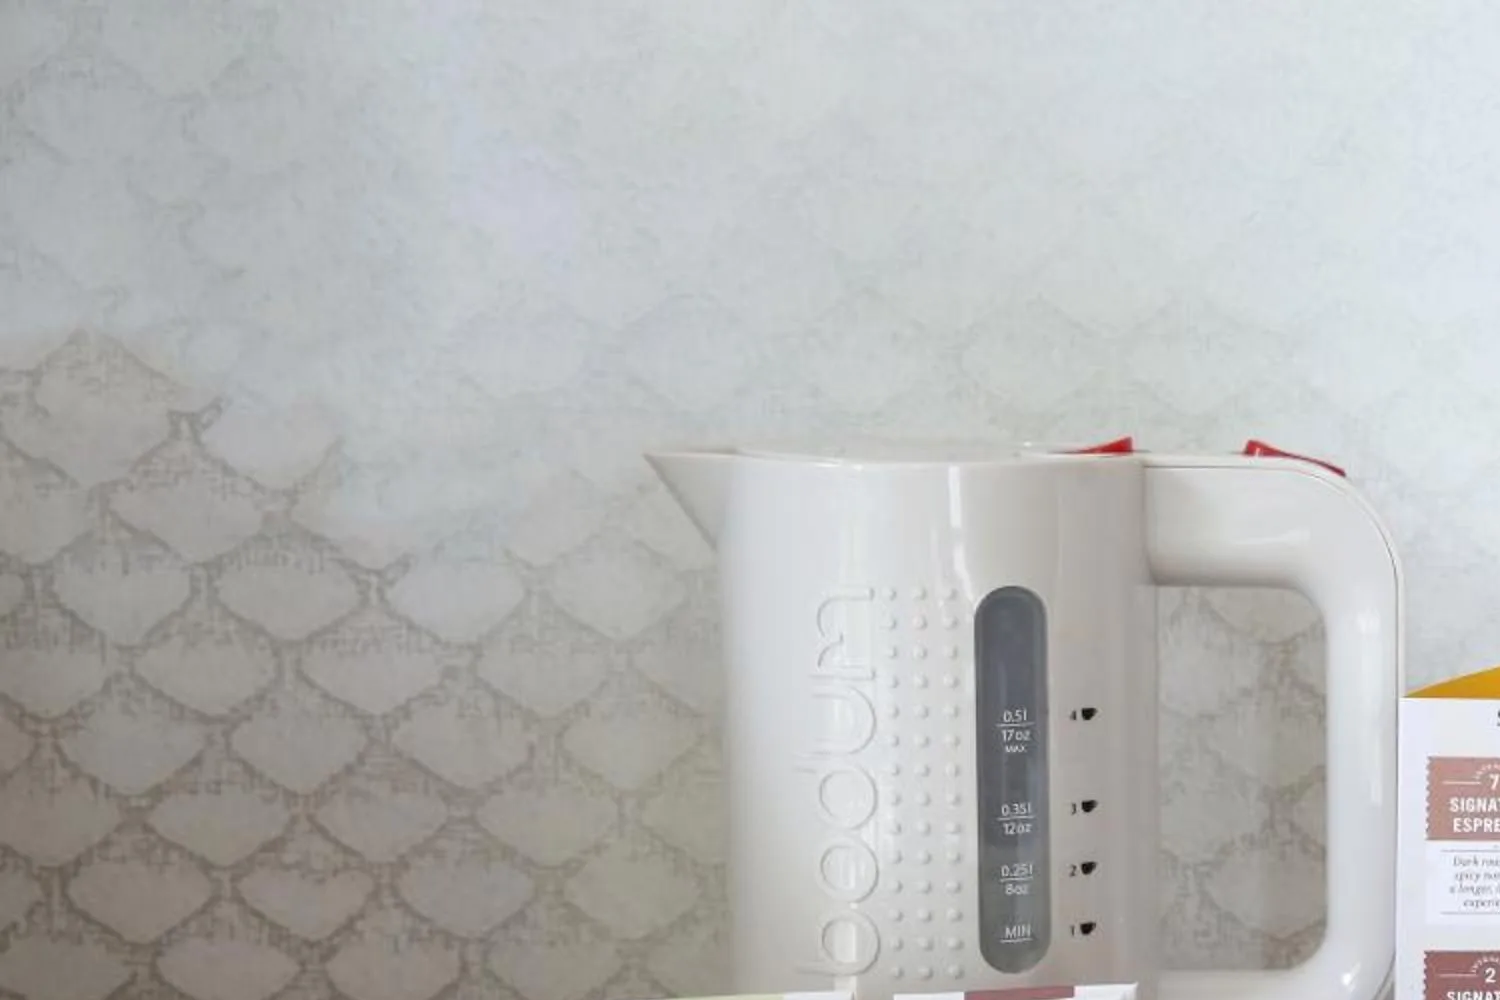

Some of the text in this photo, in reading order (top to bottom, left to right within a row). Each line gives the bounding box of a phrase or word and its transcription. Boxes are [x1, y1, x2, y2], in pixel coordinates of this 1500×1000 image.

[1489, 773, 1500, 790] 7
[1453, 856, 1479, 866] Dark
[1069, 864, 1077, 877] 2
[1005, 924, 1031, 939] MIN
[1484, 967, 1497, 983] 2
